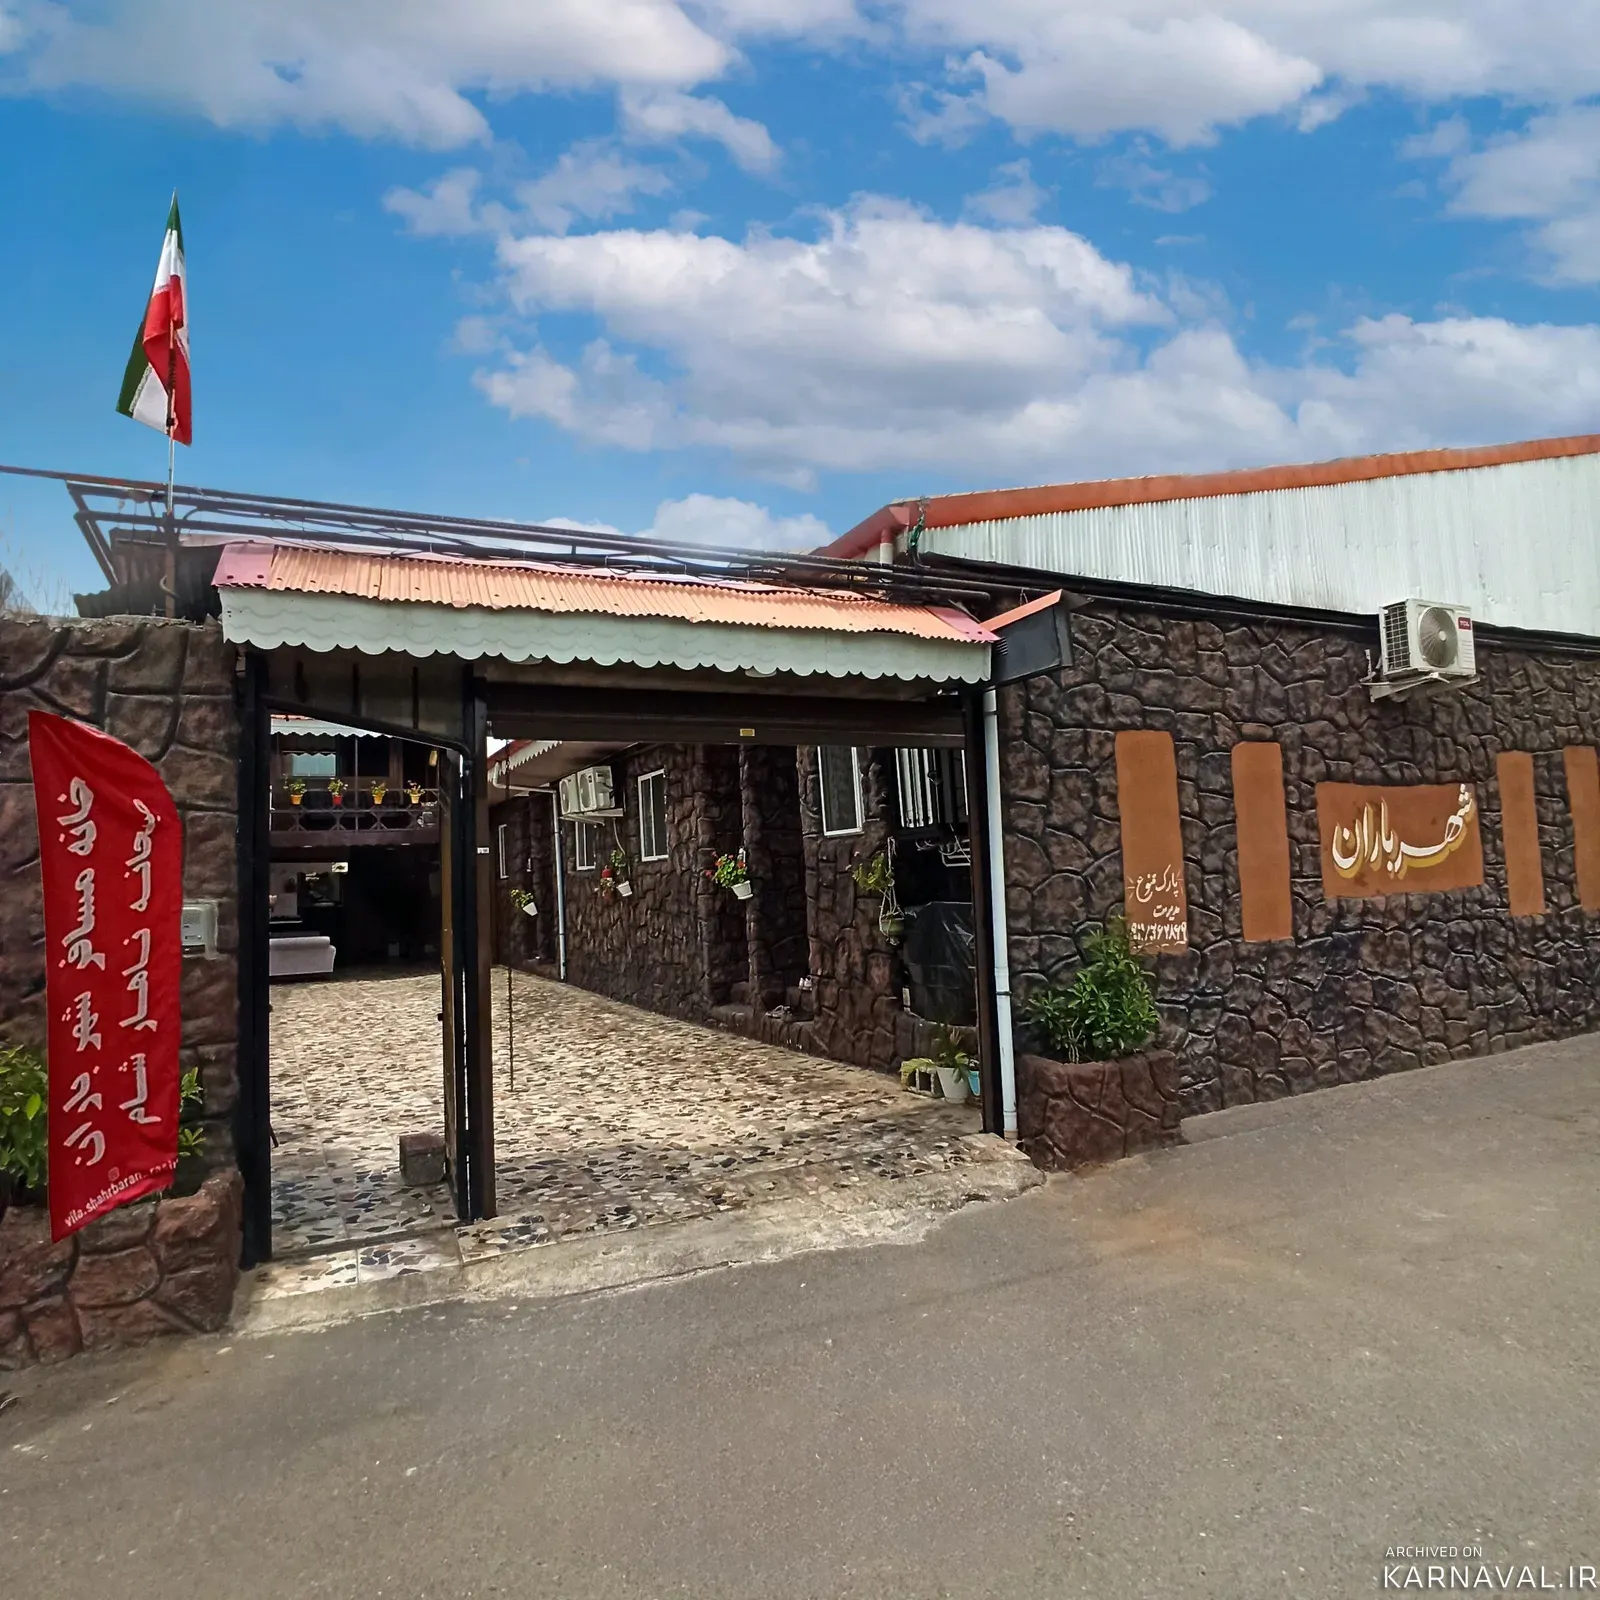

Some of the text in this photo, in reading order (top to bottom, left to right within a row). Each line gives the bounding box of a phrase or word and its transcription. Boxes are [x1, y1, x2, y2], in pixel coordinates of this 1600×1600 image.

[1332, 783, 1474, 876] شهر باران
[1153, 904, 1181, 921] مدیریت
[1155, 864, 1179, 897] پارک
[56, 776, 106, 1166] خانه مسافر شهر باران
[118, 799, 162, 1124] صبحانه ناهار شام
